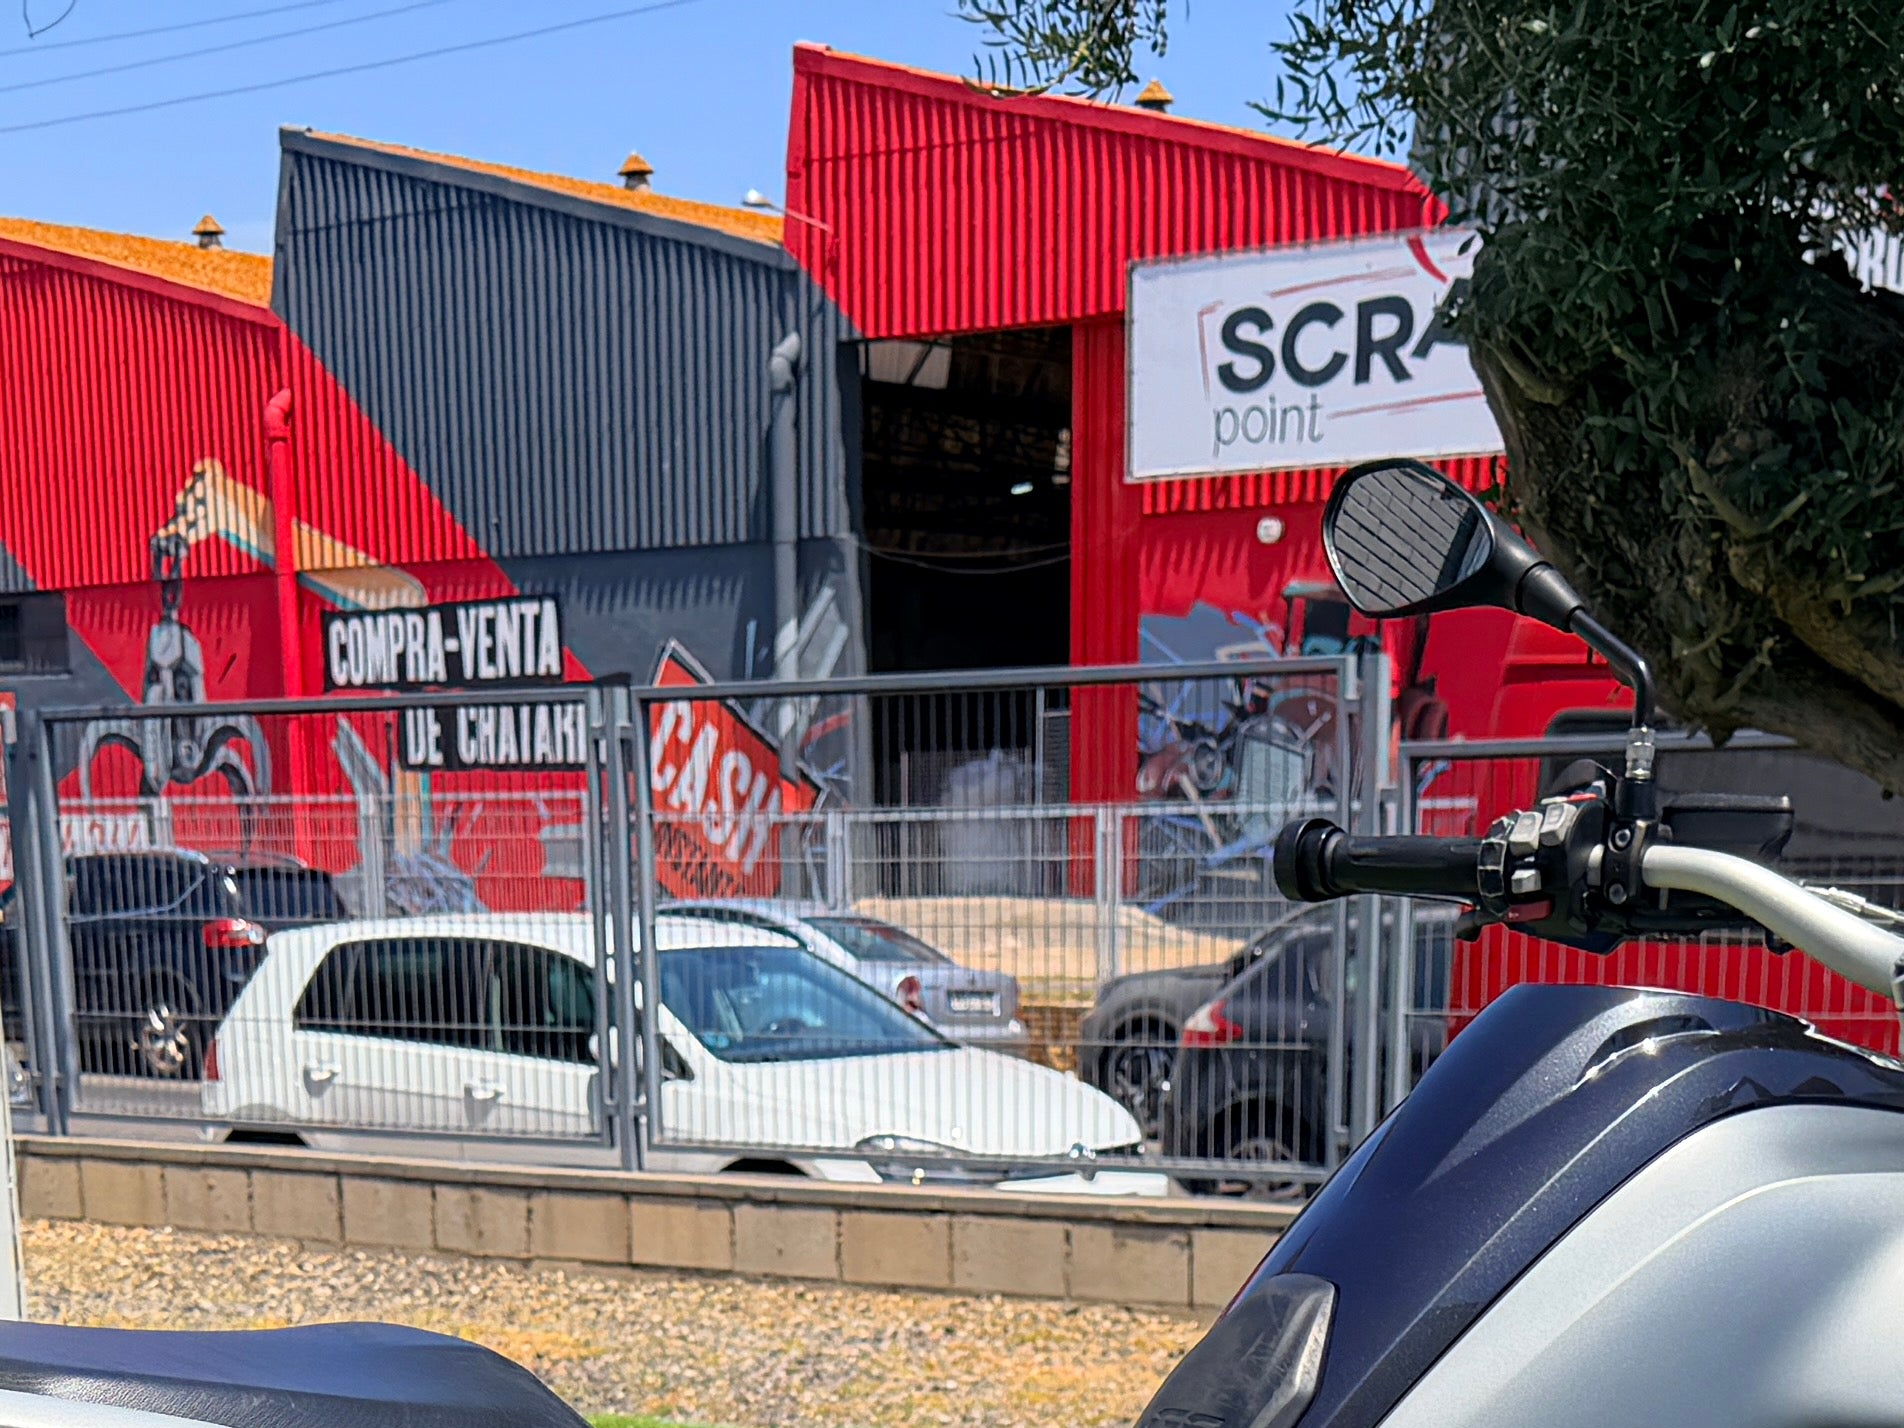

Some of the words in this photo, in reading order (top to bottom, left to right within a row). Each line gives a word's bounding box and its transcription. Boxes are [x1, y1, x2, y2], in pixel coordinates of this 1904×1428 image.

[1212, 394, 1324, 457] point
[329, 600, 562, 686] COMPRA-VENTA
[406, 708, 444, 765] DE
[651, 701, 781, 876] CASH
